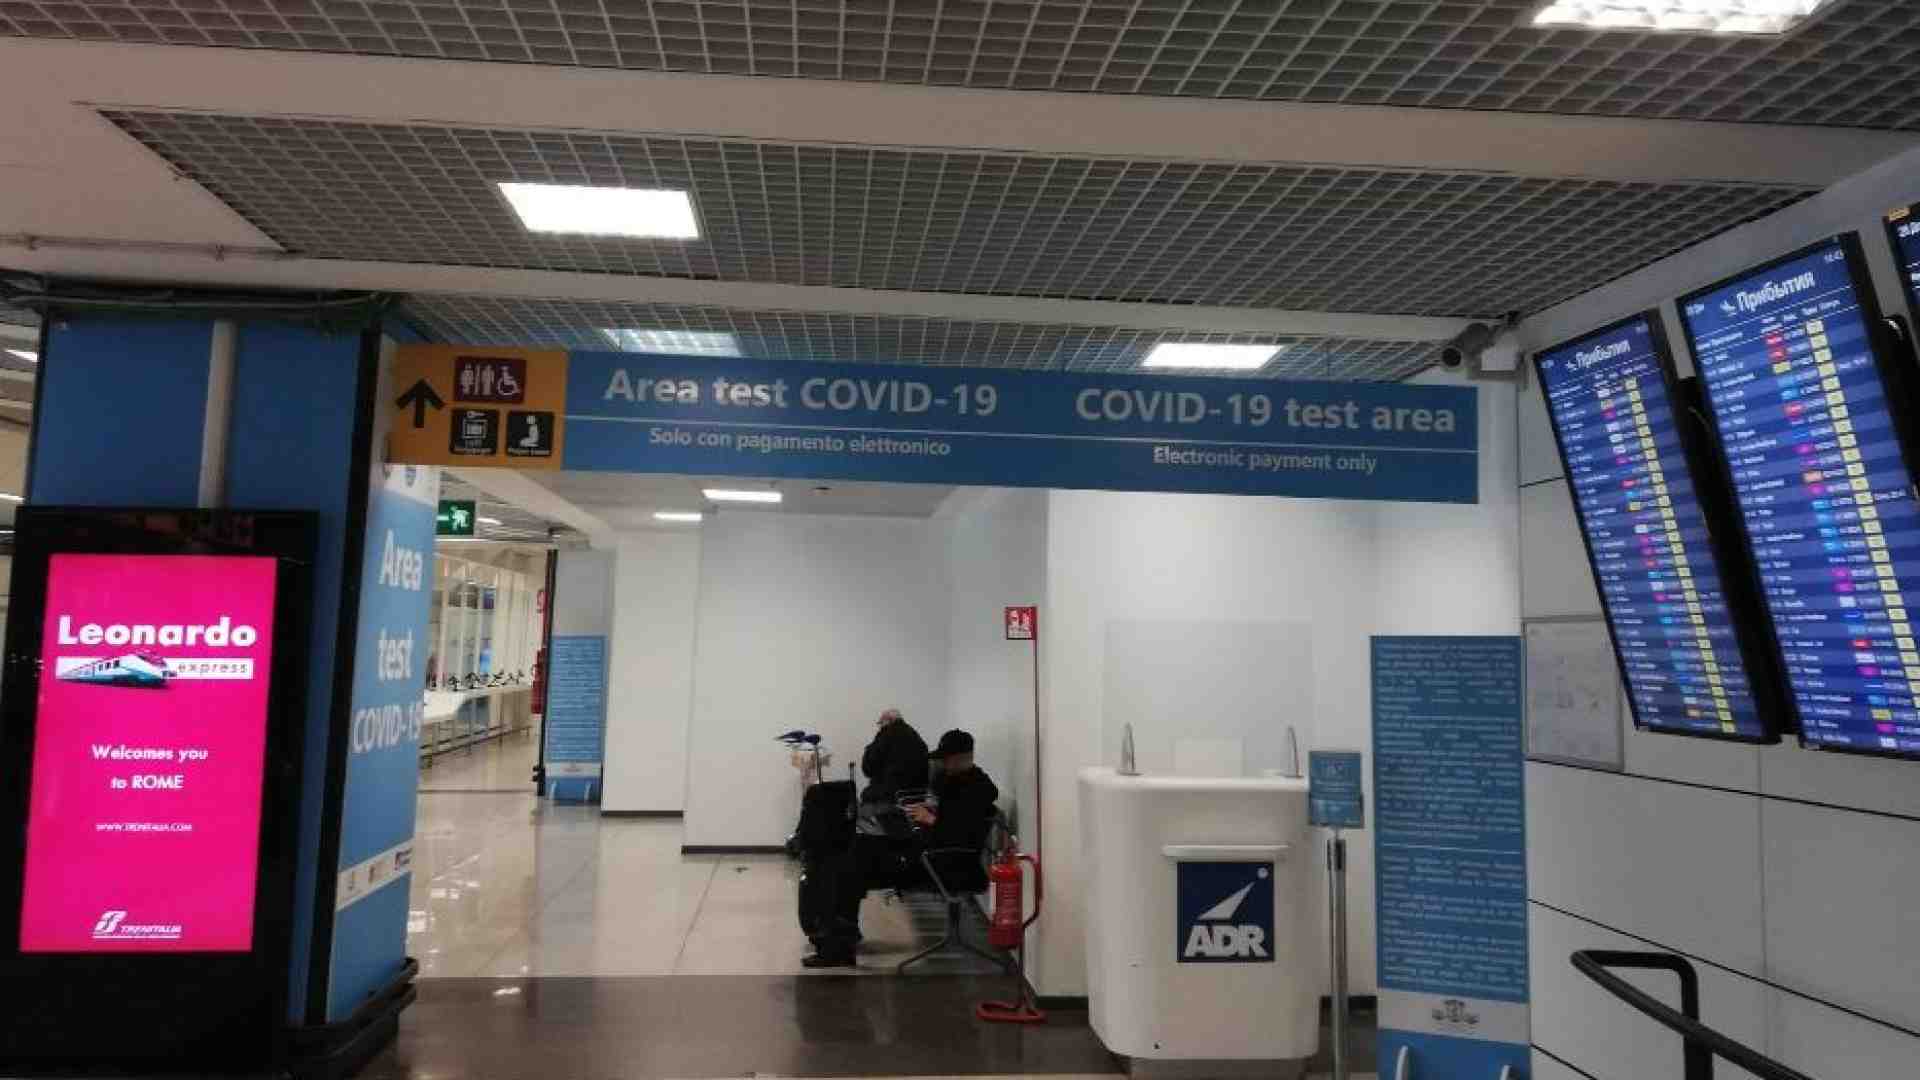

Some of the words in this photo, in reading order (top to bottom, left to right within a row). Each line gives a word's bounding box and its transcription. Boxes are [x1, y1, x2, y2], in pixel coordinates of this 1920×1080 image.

[1736, 271, 1816, 313] Прибытия
[604, 368, 699, 404] Area
[712, 376, 790, 409] test
[800, 377, 998, 417] COVID-19
[1076, 388, 1273, 427] COVID-19
[1284, 396, 1361, 430] test
[1371, 405, 1456, 433] area
[649, 427, 693, 446] Solo
[697, 431, 732, 447] con
[736, 433, 845, 454] pagamento
[849, 434, 951, 456] elettronico
[1153, 445, 1246, 466] Electronic
[1250, 451, 1332, 472] payment
[1336, 452, 1378, 475] only
[379, 529, 423, 592] Area
[57, 614, 257, 648] Leonardo
[177, 662, 249, 677] express
[378, 628, 413, 680] test
[91, 743, 175, 760] Welcomes
[177, 749, 209, 763] you
[110, 776, 128, 790] to
[131, 774, 185, 790] ROME
[1184, 924, 1268, 957] ADR
